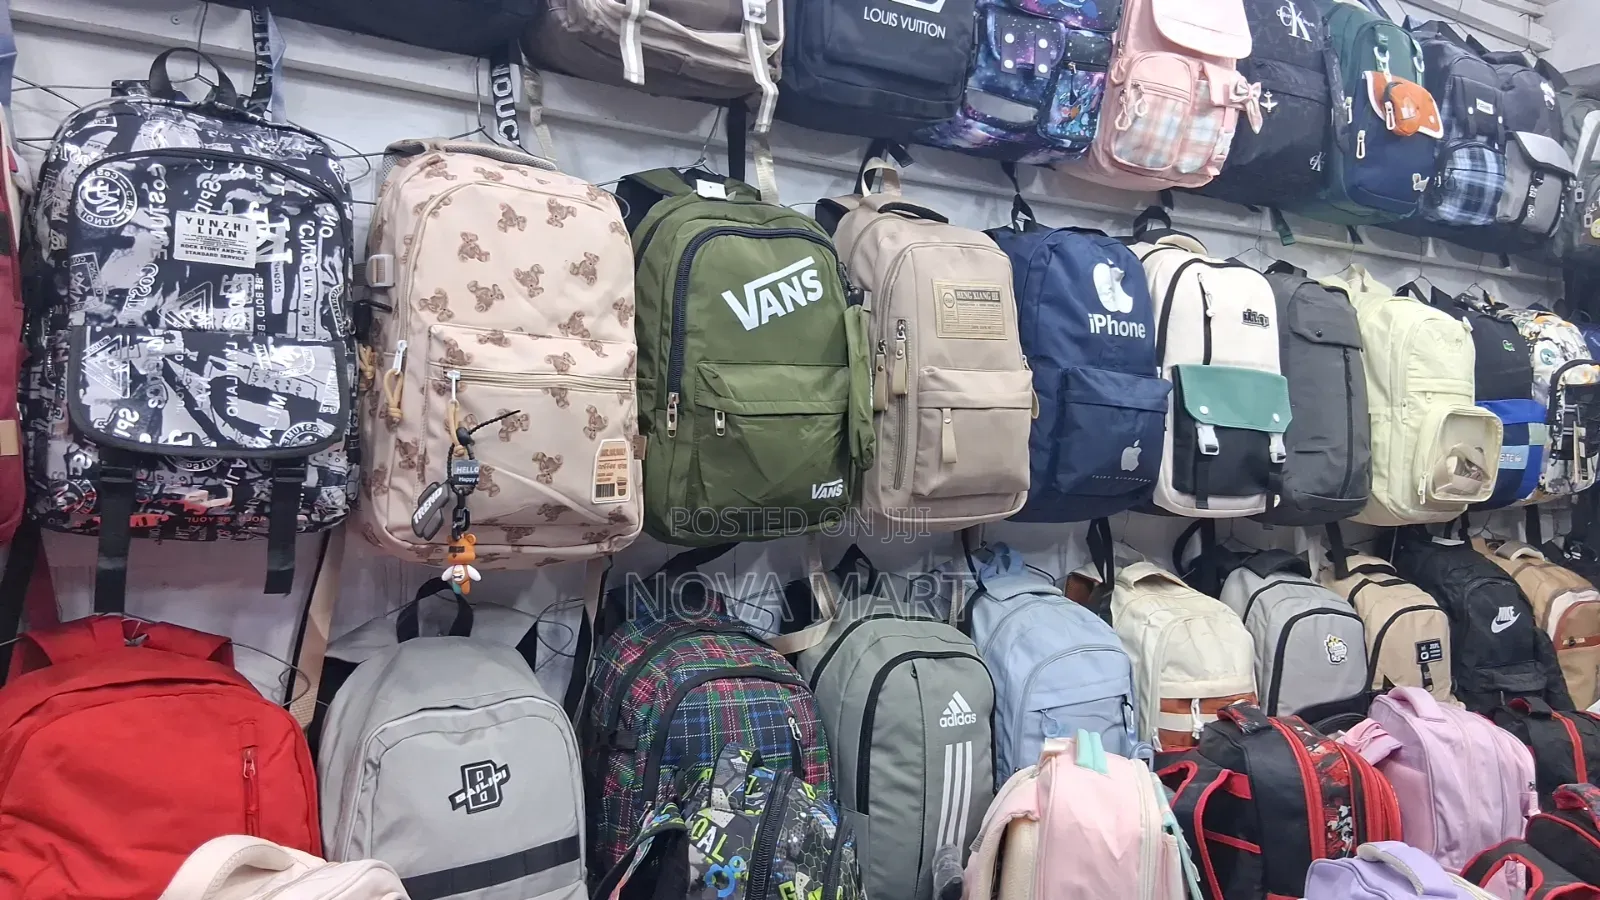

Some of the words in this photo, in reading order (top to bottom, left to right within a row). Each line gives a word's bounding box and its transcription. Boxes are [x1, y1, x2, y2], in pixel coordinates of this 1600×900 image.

[863, 7, 898, 27] LOUIS
[900, 15, 946, 40] VUITTON
[185, 216, 249, 232] YUNZHI
[198, 226, 237, 238] LIAN
[721, 255, 824, 332] VANS
[1088, 313, 1147, 339] iPhone
[456, 466, 479, 474] HELLO
[811, 478, 844, 500] VANS
[412, 487, 443, 525] TREND
[939, 711, 977, 728] adidas
